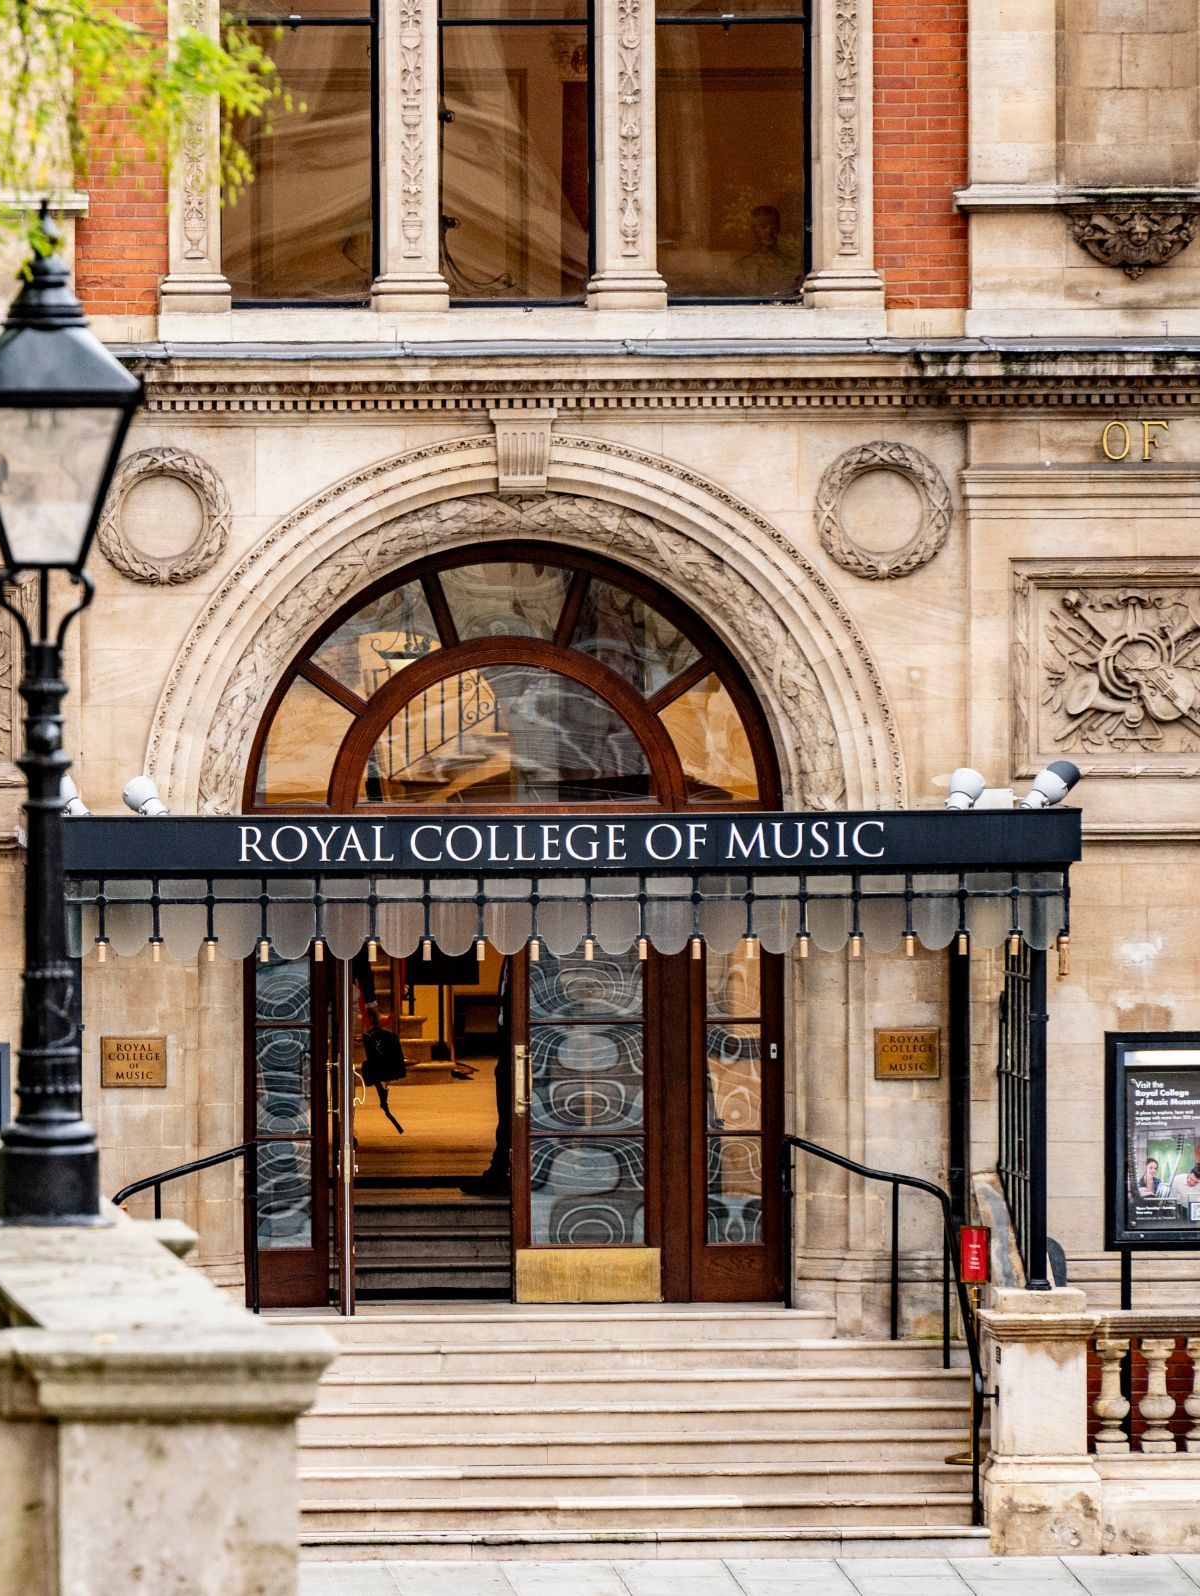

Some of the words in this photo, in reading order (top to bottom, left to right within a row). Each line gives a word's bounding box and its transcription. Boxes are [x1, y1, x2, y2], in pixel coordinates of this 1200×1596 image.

[1103, 421, 1169, 461] OF
[238, 825, 394, 862] ROYAL
[410, 824, 627, 862] COLLEGE
[645, 823, 707, 860] OF
[725, 821, 885, 859] MUSIC
[890, 1035, 927, 1043] ROYAL
[116, 1043, 153, 1052] ROYAL
[882, 1044, 934, 1053] COLLEGE
[108, 1052, 161, 1061] COLLEGE
[889, 1063, 927, 1072] MUSIC
[115, 1071, 153, 1080] MUSIC
[1135, 1081, 1151, 1089] Visit
[1152, 1081, 1165, 1089] the
[1135, 1089, 1159, 1098] Royal
[1160, 1089, 1190, 1098] College
[1135, 1098, 1144, 1106] of
[1145, 1098, 1169, 1106] Music
